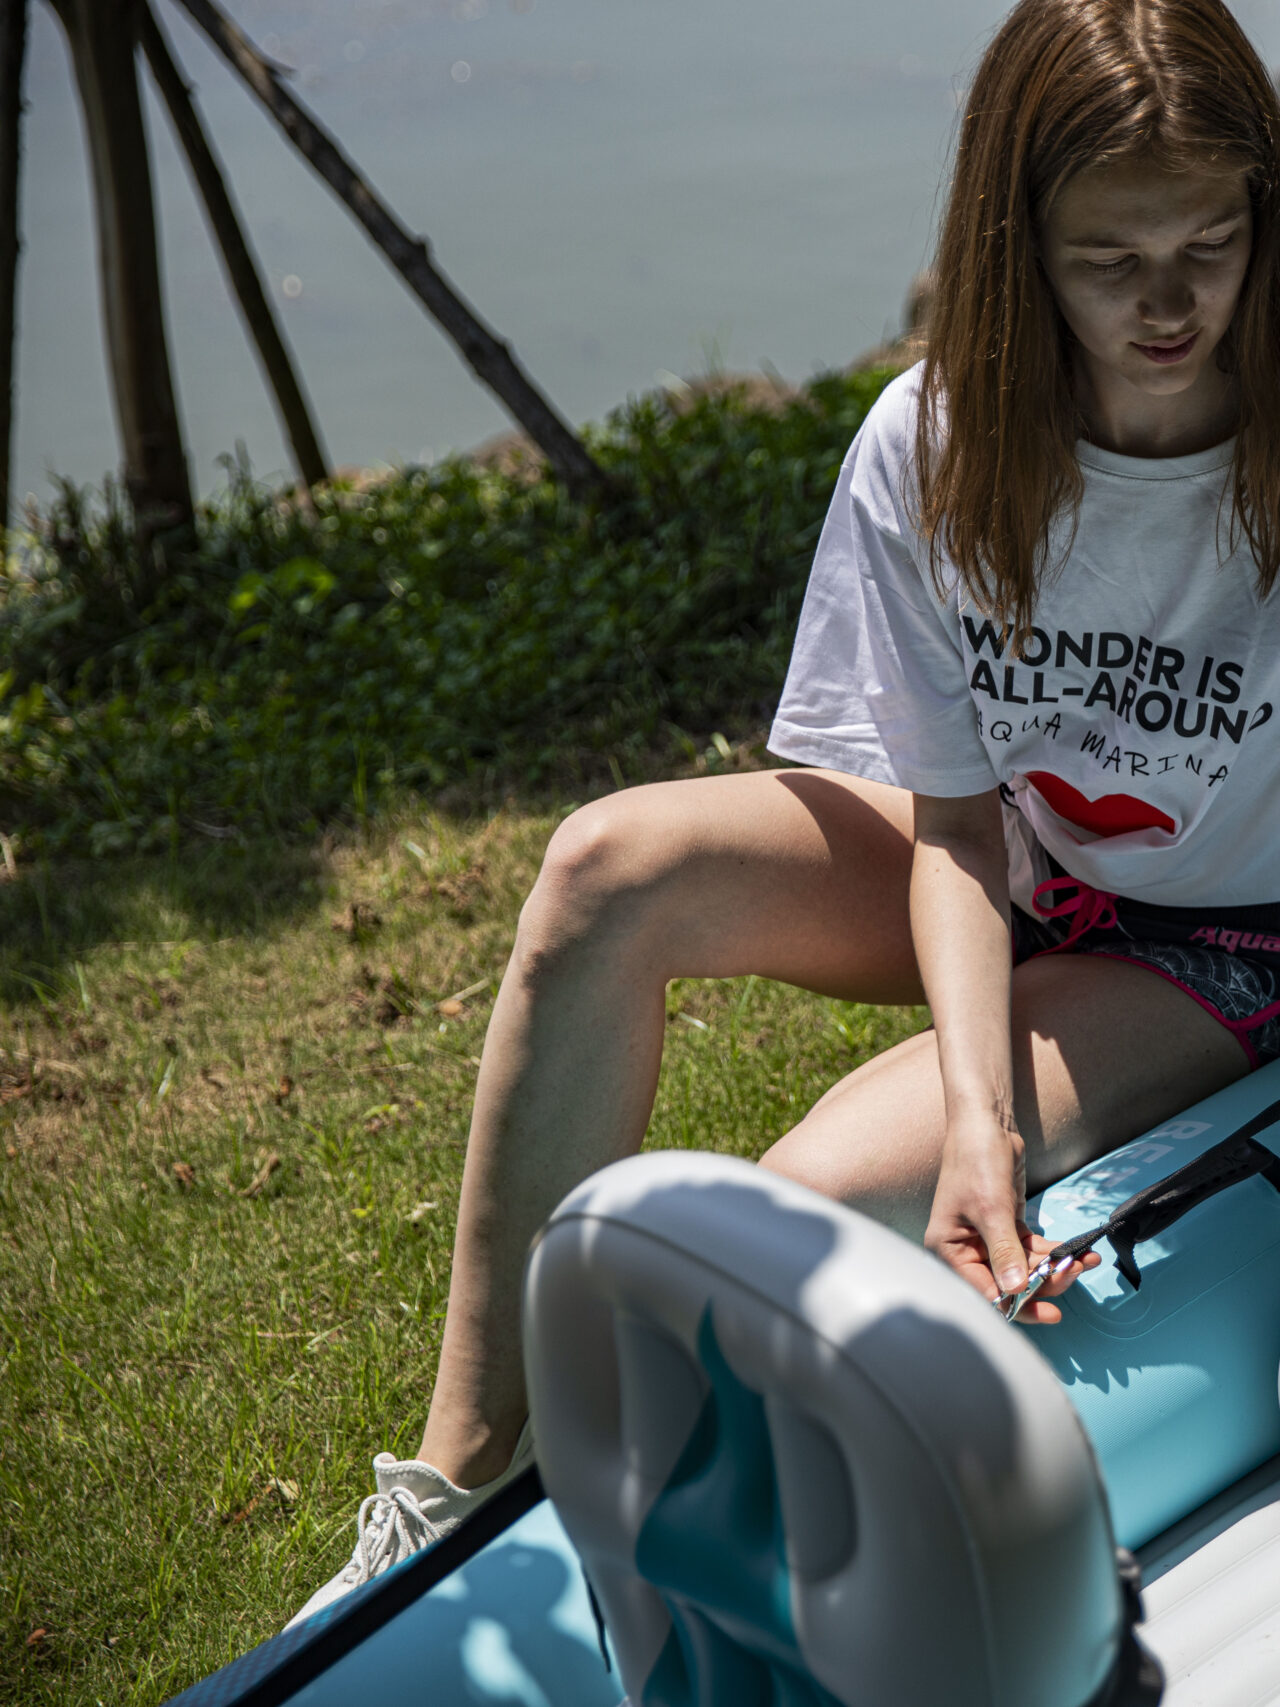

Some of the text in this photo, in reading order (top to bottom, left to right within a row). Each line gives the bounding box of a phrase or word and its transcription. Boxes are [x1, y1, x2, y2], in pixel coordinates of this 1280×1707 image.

[961, 615, 1243, 703] WONDER IS
[1080, 730, 1229, 787] MARINA
